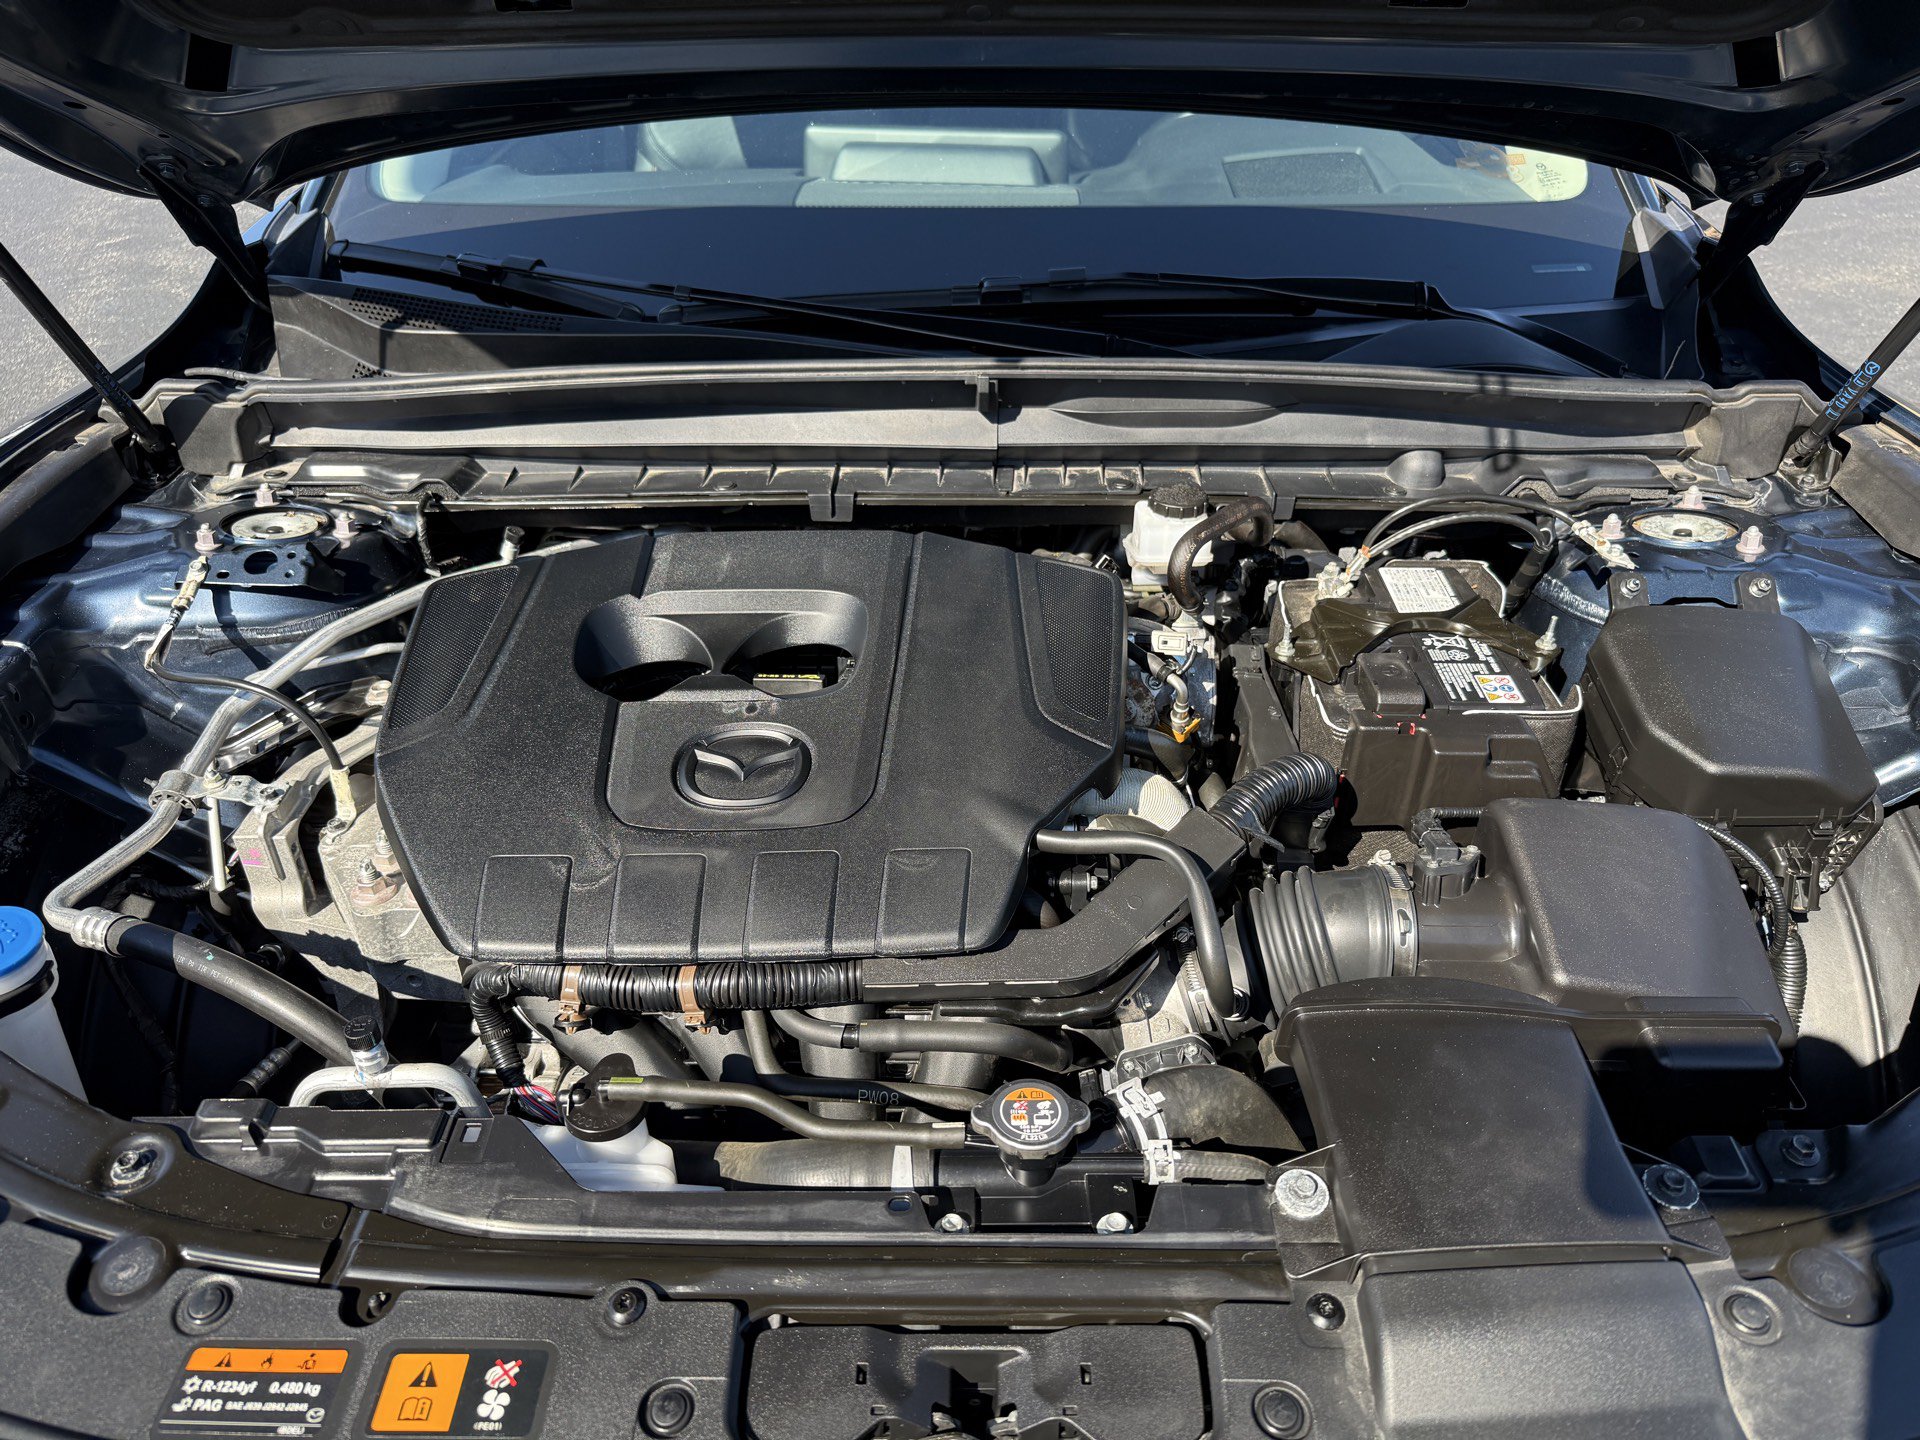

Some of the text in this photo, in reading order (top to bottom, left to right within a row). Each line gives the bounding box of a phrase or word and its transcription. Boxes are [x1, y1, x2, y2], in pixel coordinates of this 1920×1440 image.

[858, 1089, 899, 1105] PW08
[201, 1380, 258, 1395] R-1234yf
[303, 1382, 321, 1397] kg
[192, 1399, 223, 1411] PAG
